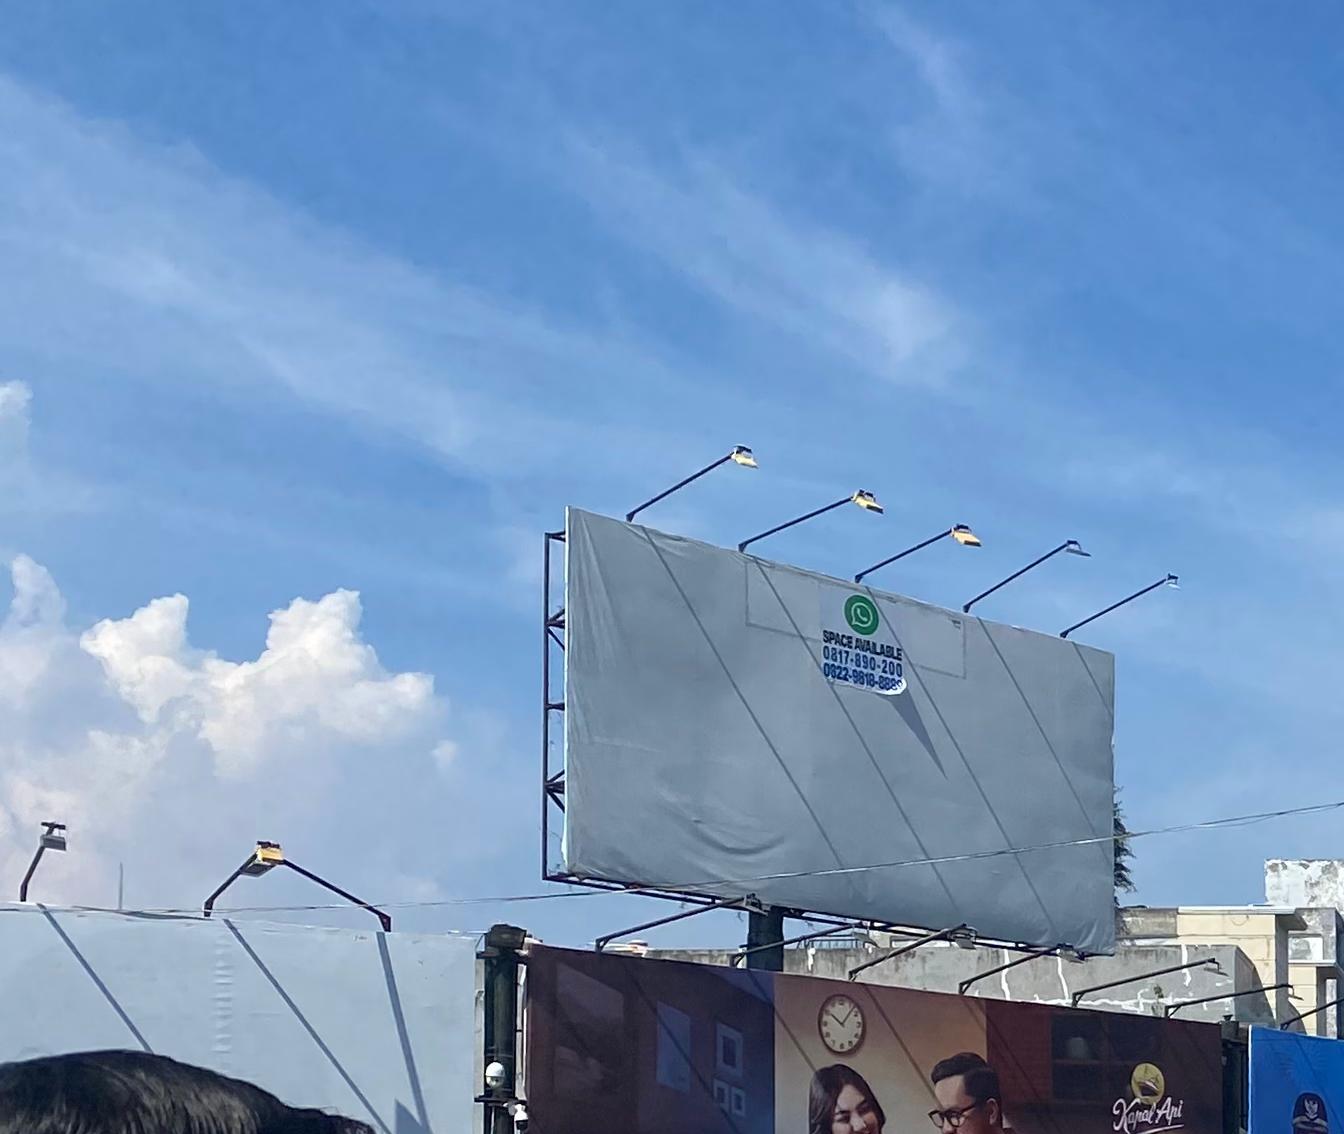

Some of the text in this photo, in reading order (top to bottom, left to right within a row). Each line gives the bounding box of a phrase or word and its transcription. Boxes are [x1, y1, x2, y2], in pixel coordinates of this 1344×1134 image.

[823, 629, 902, 661] SPACE AVAILABLE
[823, 645, 903, 677] 0817-890-200
[1112, 1097, 1184, 1134] Kapal Api
